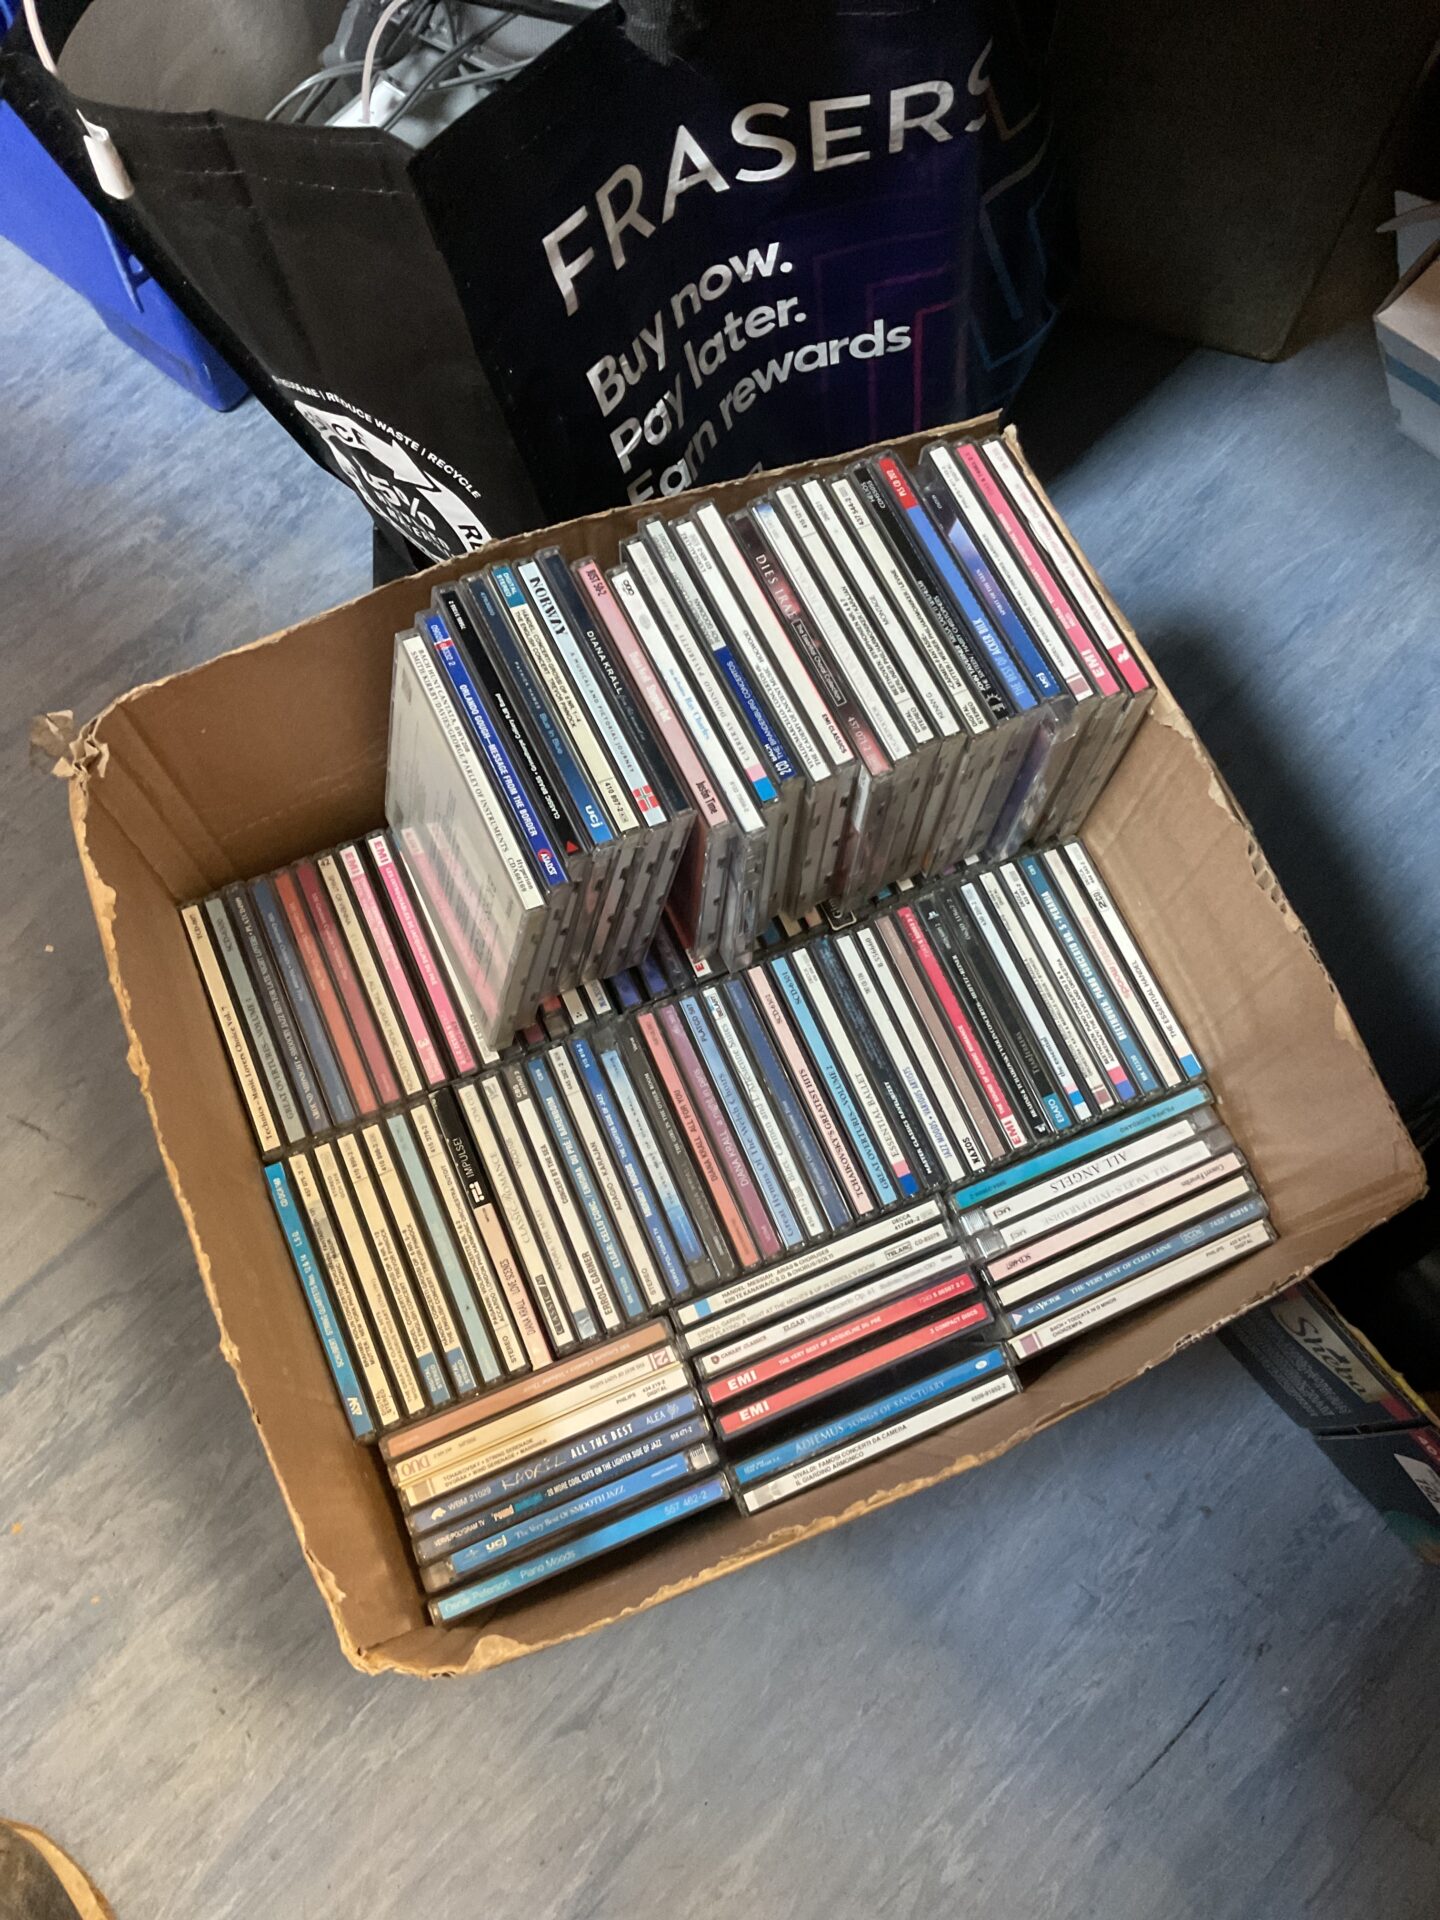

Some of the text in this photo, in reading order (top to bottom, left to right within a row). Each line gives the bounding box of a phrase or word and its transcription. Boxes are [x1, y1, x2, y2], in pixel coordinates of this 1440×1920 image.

[585, 241, 793, 417] Buy now.
[609, 296, 807, 474] Pay later.
[719, 319, 912, 431] rewards
[325, 392, 373, 423] REDUCE
[374, 417, 420, 452] WASTE
[427, 452, 482, 500] RECYCLE
[495, 573, 512, 598] STEREO
[502, 571, 517, 594] DIGITAL
[586, 568, 599, 584] JUST
[755, 553, 798, 620] DIES IRAE
[528, 575, 568, 638] NORWAY
[869, 594, 890, 625] MONTAGE
[586, 629, 623, 694] DIANA KRALL
[972, 616, 1025, 696] THE BEST OF ACKER BILK
[1081, 647, 1105, 678] EMI
[1035, 670, 1051, 689] ucj
[726, 659, 783, 758] THE BRANDENBURG CONCERTOS
[821, 713, 846, 754] EMI CLASSICS
[458, 683, 538, 837] ORLANDO FROM THE BORDER
[695, 779, 719, 814] Justin Time
[582, 803, 603, 829] ucj
[344, 851, 359, 875] EMI
[372, 840, 388, 863] EMI
[514, 858, 534, 890] Hyperion
[1130, 959, 1150, 987] HANDEL
[221, 1010, 233, 1026] Vol.
[685, 1002, 708, 1042] PLATCD 587
[1145, 986, 1170, 1024] ESSENTIAL
[227, 1026, 243, 1053] Choice
[1165, 1023, 1178, 1038] THE
[236, 1052, 252, 1078] Lovers
[245, 1077, 259, 1099] Music
[255, 1105, 273, 1140] Technics
[691, 1067, 749, 1186] DIANA KRALL night paris
[852, 1070, 901, 1158] ESSENTIAL BALLET
[883, 1079, 932, 1174] MASTER CLASSICS RAVEL/BIZET
[901, 1066, 952, 1159] JAZZ MOODS VARIOUS ARTISTS
[1047, 1097, 1065, 1123] ERATO
[672, 1088, 718, 1181] DIANA KRALL ALL FOR YOU
[798, 1067, 864, 1197] TCHAIKOVSKY'S GREATEST HITS
[962, 1136, 980, 1164] NAXOS
[1004, 1119, 1021, 1145] EMI
[716, 1072, 796, 1237] Great Hymns Of The Welsh Choirs
[1048, 1150, 1128, 1193] ALL ANGELS
[539, 1143, 569, 1204] CONCERT BY THE SEA
[545, 1096, 621, 1268] ELGAR: CELLO CONC. ENIGMA DU BARENBOIM
[589, 1140, 623, 1211] ADAGIO KARAJAN
[871, 1160, 889, 1189] GREAT
[991, 1203, 1011, 1218] ucj
[451, 1135, 536, 1335] DIANA KRALL LOVE SCENES IMPULSE!
[580, 1250, 613, 1315] ERROLL GARNER
[640, 1267, 656, 1295] STEREO
[1070, 1242, 1172, 1294] THE VERY BEST OF CLEO LAINE
[934, 1316, 960, 1332] COMPACT
[960, 1308, 978, 1320] DISCS
[502, 1334, 517, 1363] STEREO
[1280, 1313, 1368, 1395] Sheba
[726, 1370, 758, 1391] EMI
[644, 1409, 666, 1425] ALEA
[738, 1400, 770, 1421] EMI
[793, 1379, 945, 1453] ADIEMUS SONGS OF SANCTUARY
[569, 1423, 634, 1458] ALL THE BEST
[818, 1424, 907, 1468] FAMOSI CONCERTI DA CAMERA
[399, 1454, 430, 1476] DUO
[552, 1438, 662, 1493] MORE COOL CUTS ON THE LIGHTER SIDE OF JAZZ
[801, 1450, 864, 1483] GIARDINO ARMONICO
[515, 1485, 626, 1539] The Very Best Of SMOOTH JAZZ
[484, 1535, 508, 1553] ucj
[519, 1490, 708, 1580] Piano Moods 557 462-2
